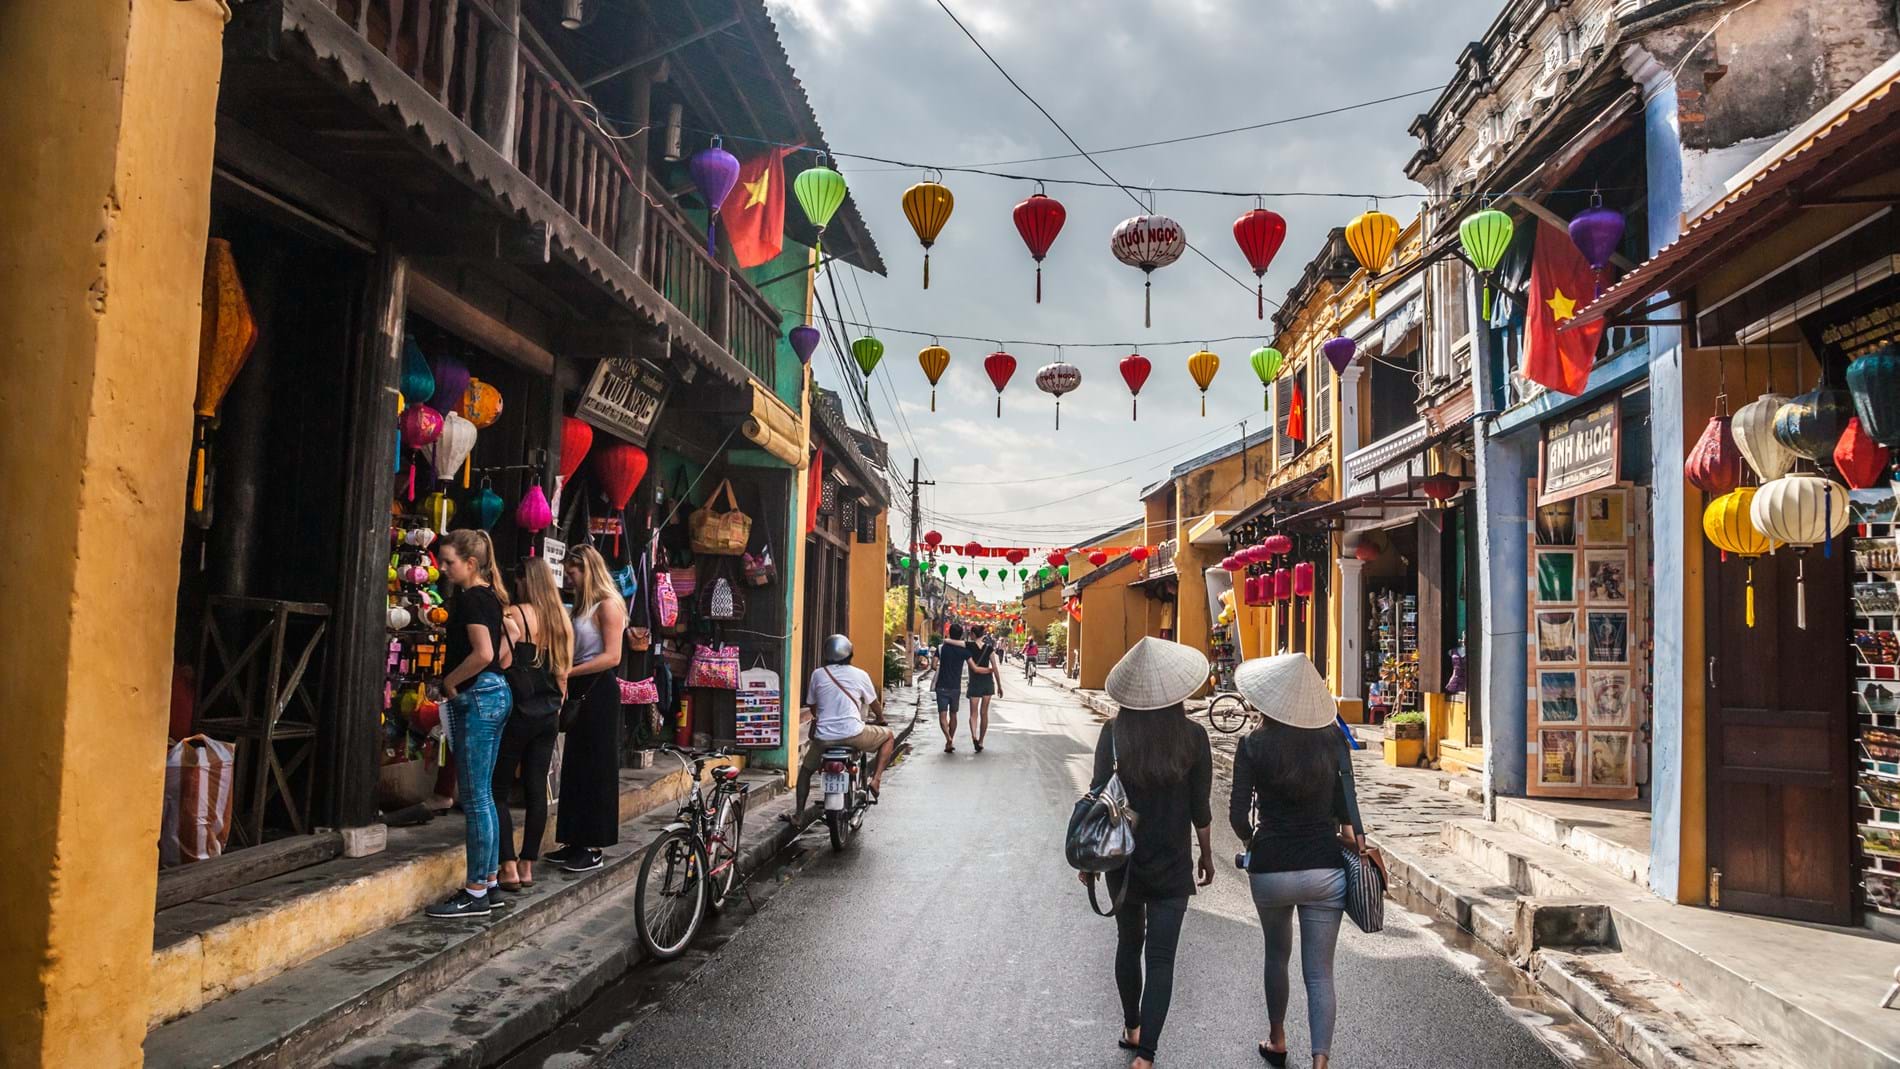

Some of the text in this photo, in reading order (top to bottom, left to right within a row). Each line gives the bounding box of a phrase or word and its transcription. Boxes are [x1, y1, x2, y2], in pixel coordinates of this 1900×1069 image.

[1148, 227, 1178, 246] NGỌC
[1549, 437, 1574, 471] ANH
[1575, 421, 1612, 462] KHOA
